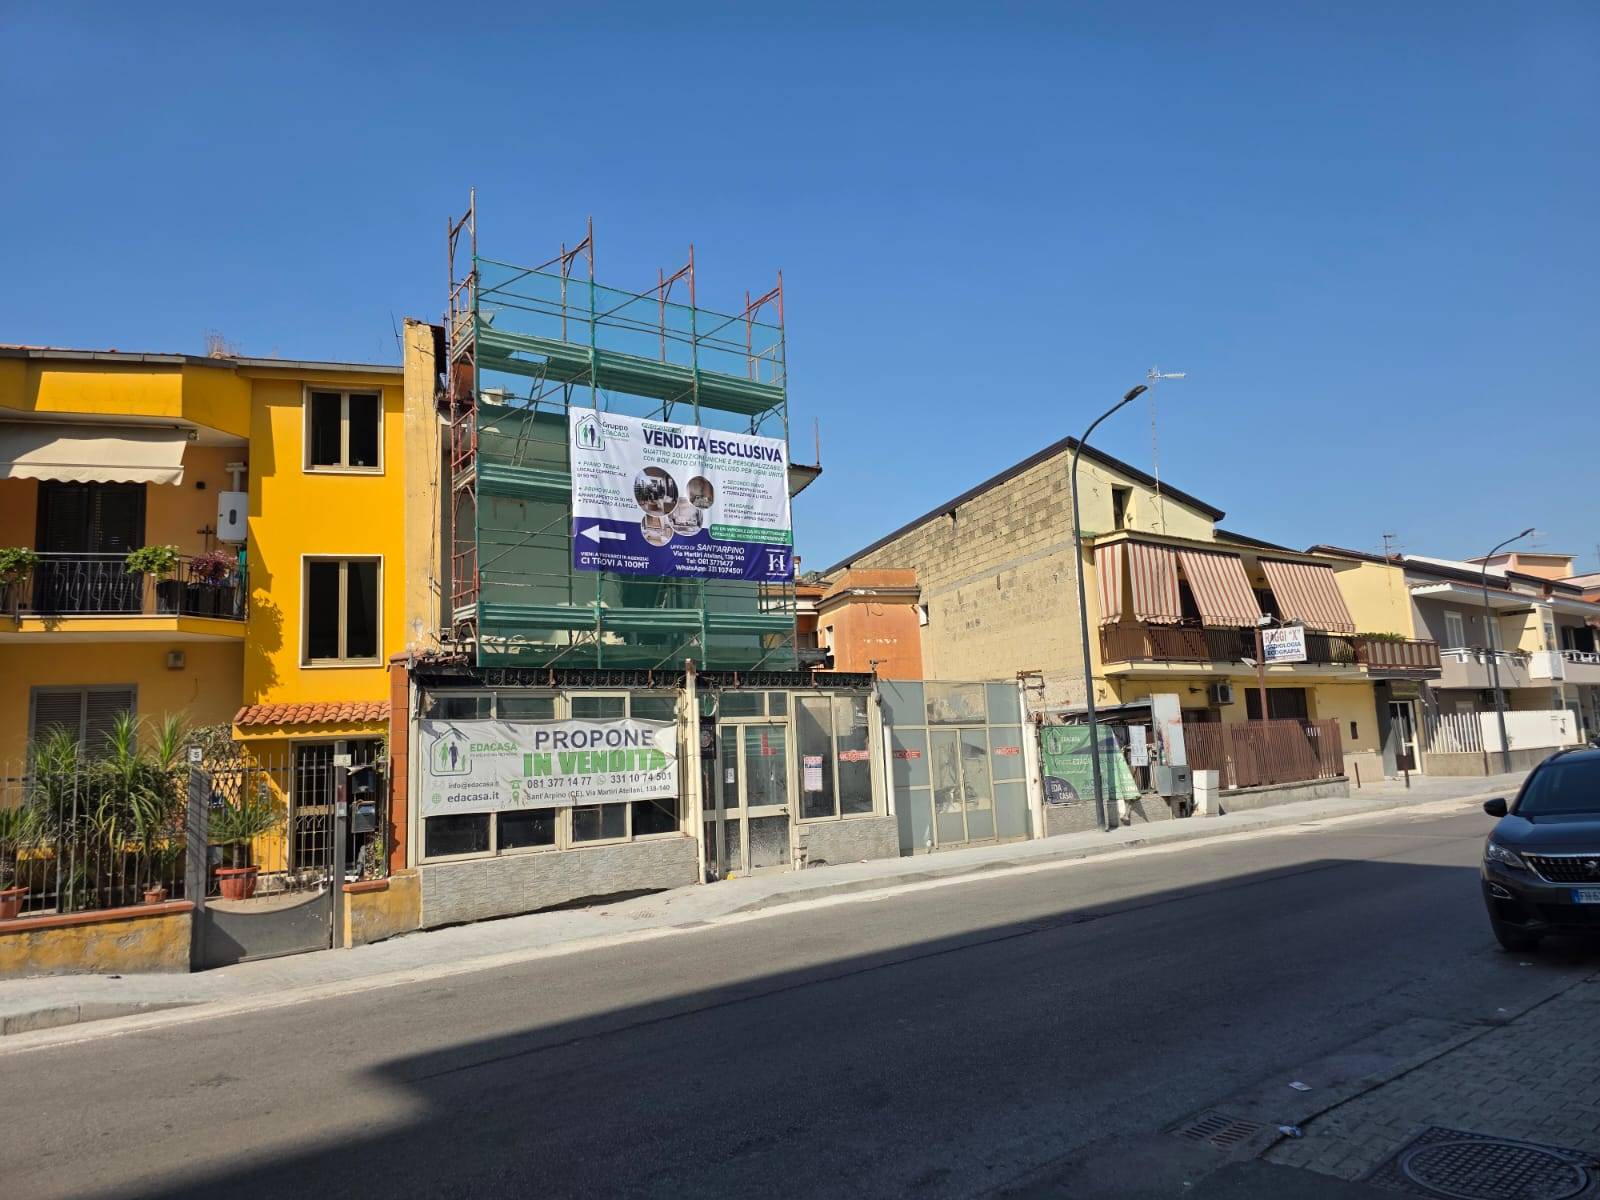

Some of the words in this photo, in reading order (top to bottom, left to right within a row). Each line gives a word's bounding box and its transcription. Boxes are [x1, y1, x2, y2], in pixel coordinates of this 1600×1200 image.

[603, 421, 628, 431] Gruppo
[643, 429, 706, 452] VENDITA
[710, 440, 782, 462] ESCLUSIVA
[642, 448, 670, 456] QUATTRO
[696, 544, 744, 554] SANT'ARPINO
[581, 556, 590, 564] CI
[592, 557, 615, 567] TROVI
[624, 560, 650, 568] 100MT
[1264, 630, 1287, 642] RAGGI
[536, 729, 654, 750] PROPONE
[470, 742, 518, 752] EDACASA
[523, 752, 552, 778] IN
[558, 748, 666, 775] VENDITA
[528, 779, 544, 788] 081
[548, 778, 564, 788] 377
[568, 777, 578, 786] 14
[581, 776, 592, 786] 77
[610, 774, 626, 784] 331
[630, 774, 640, 782] 10
[642, 773, 654, 782] 74
[656, 772, 672, 781] 501
[448, 792, 499, 802] edacasa.it
[527, 792, 566, 800] Sant'Arpino
